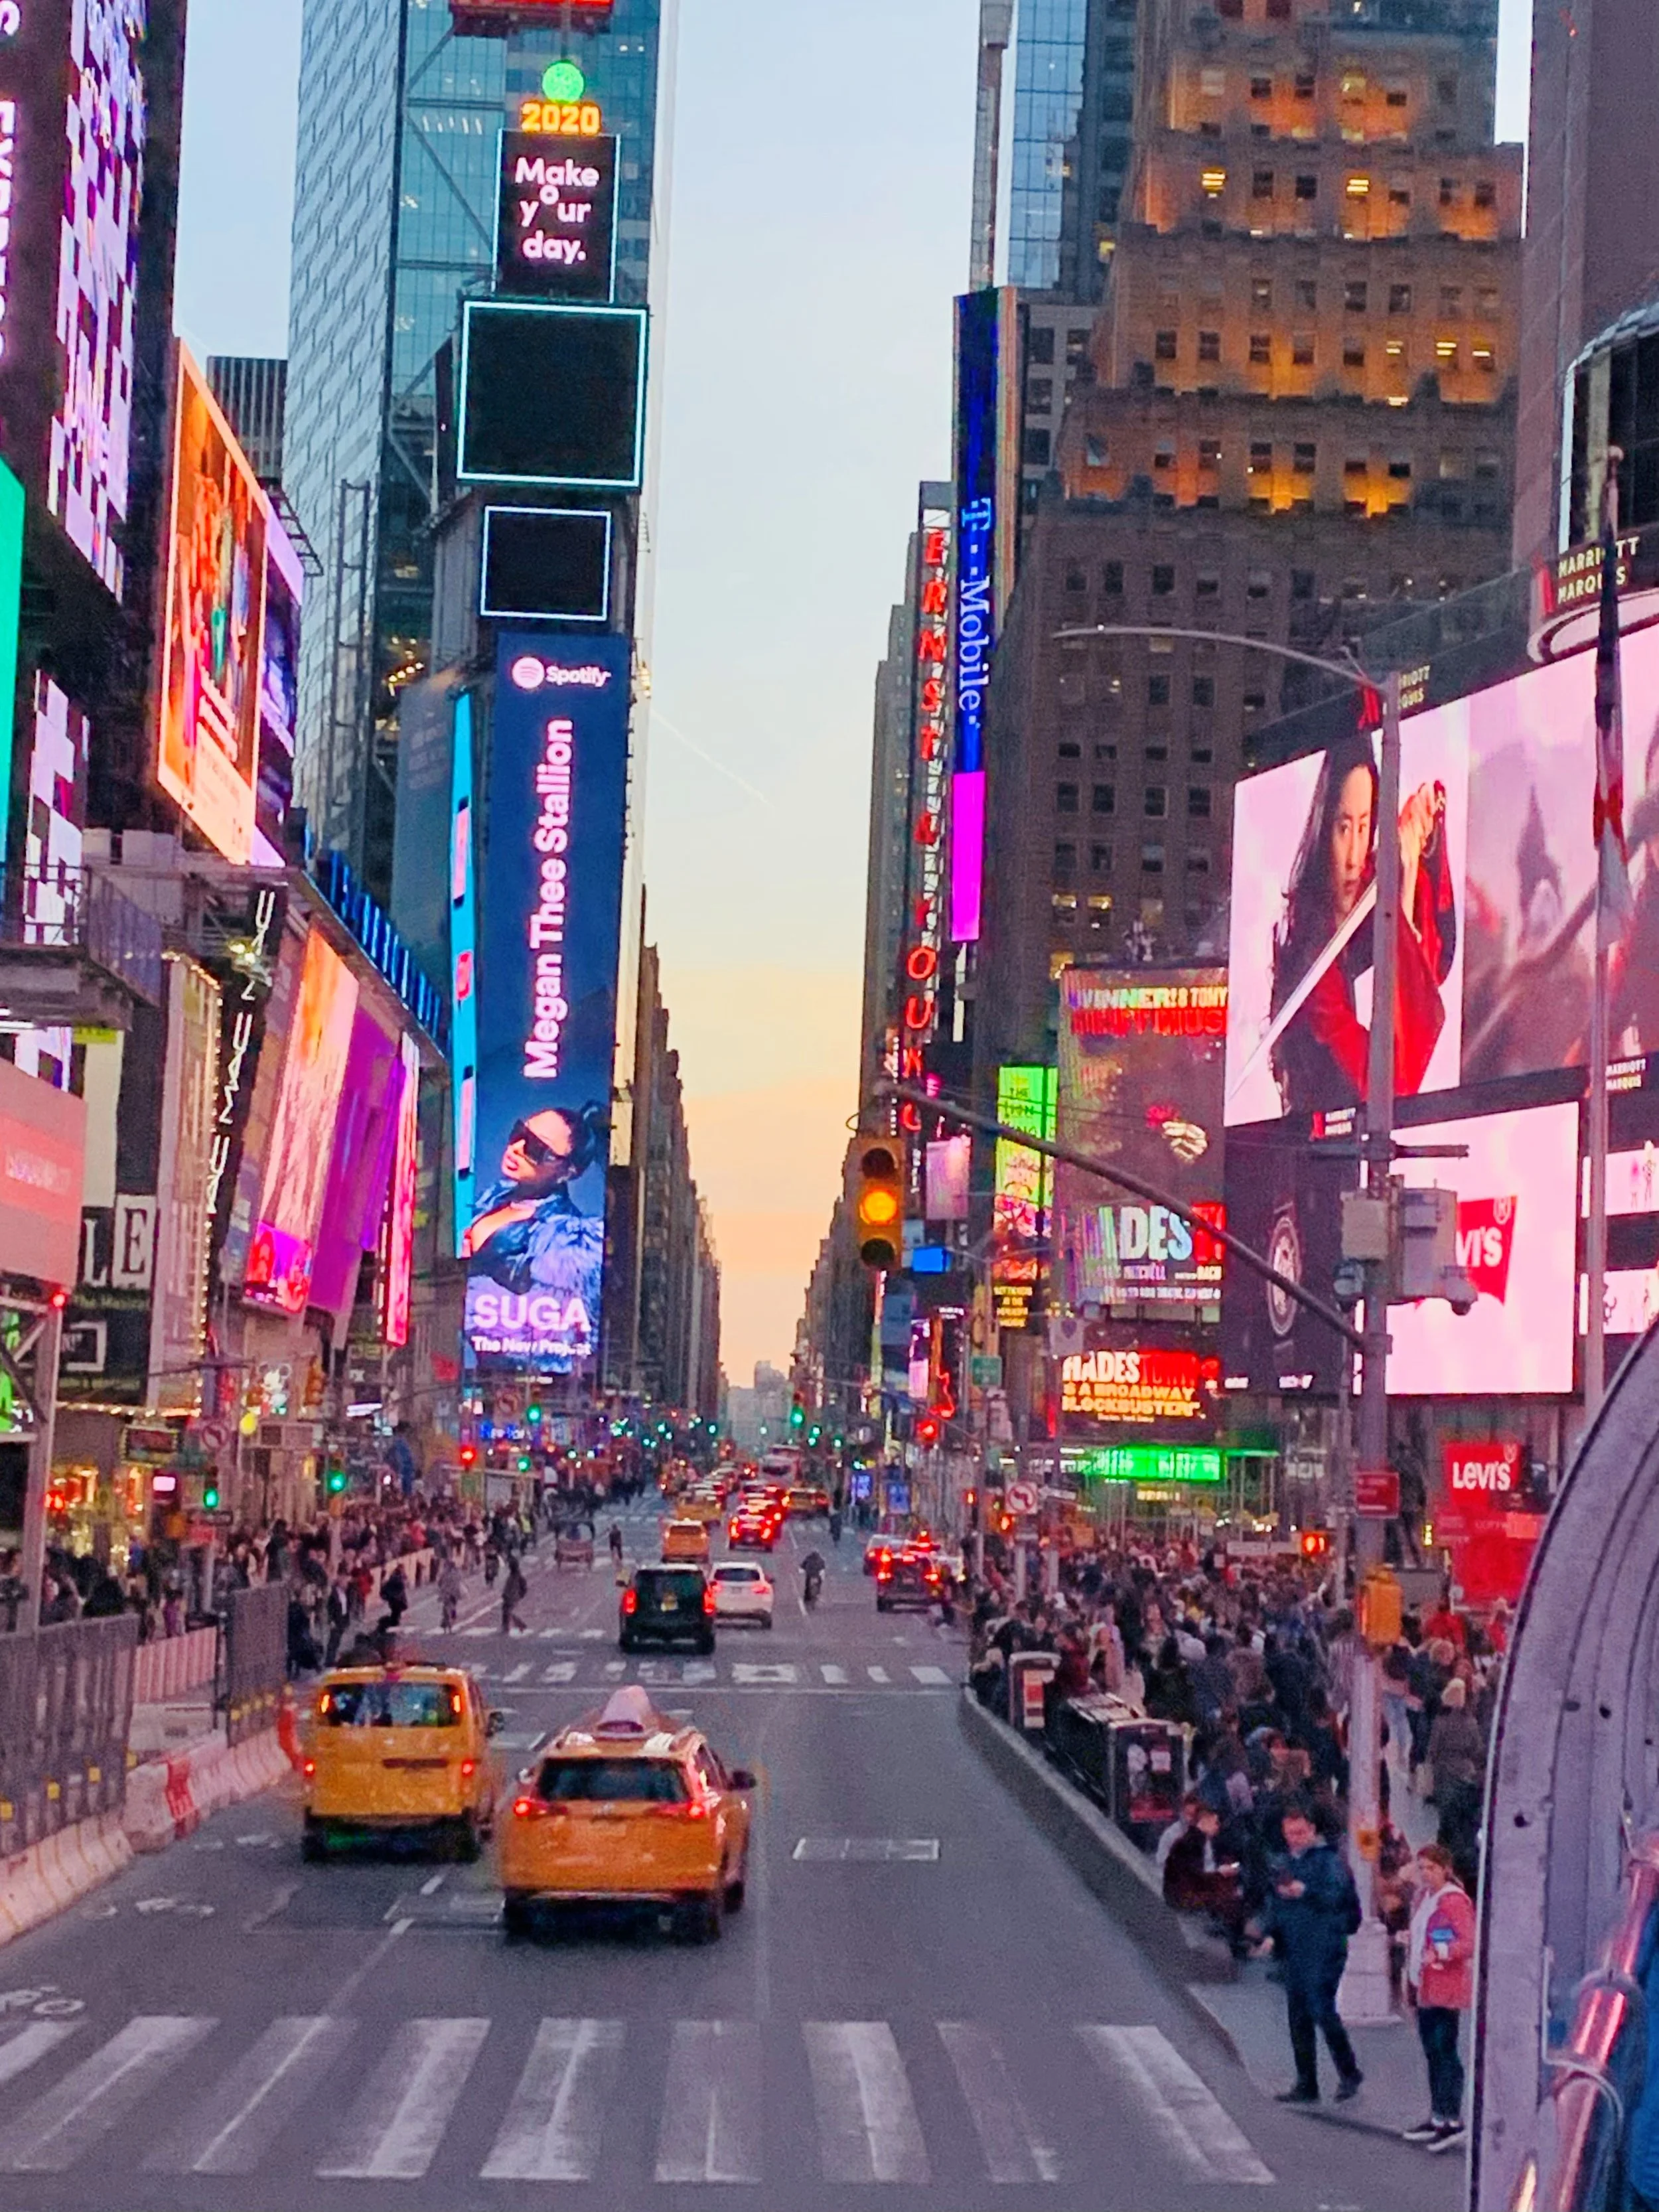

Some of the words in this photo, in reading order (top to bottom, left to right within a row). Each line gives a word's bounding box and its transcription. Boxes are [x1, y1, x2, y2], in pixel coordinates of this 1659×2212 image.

[521, 102, 601, 135] 2020
[515, 157, 599, 187] Make
[520, 184, 591, 226] your
[522, 230, 587, 264] day.
[1559, 536, 1640, 579] MARRITT
[1558, 566, 1626, 605] MARQS
[546, 666, 611, 688] Spotify
[534, 719, 573, 853] Stallion
[530, 857, 567, 949] Thee
[523, 953, 567, 1078] Megan
[473, 1293, 591, 1333] SUGA
[471, 1336, 501, 1353] The
[1094, 1383, 1195, 1401] BROADWAY
